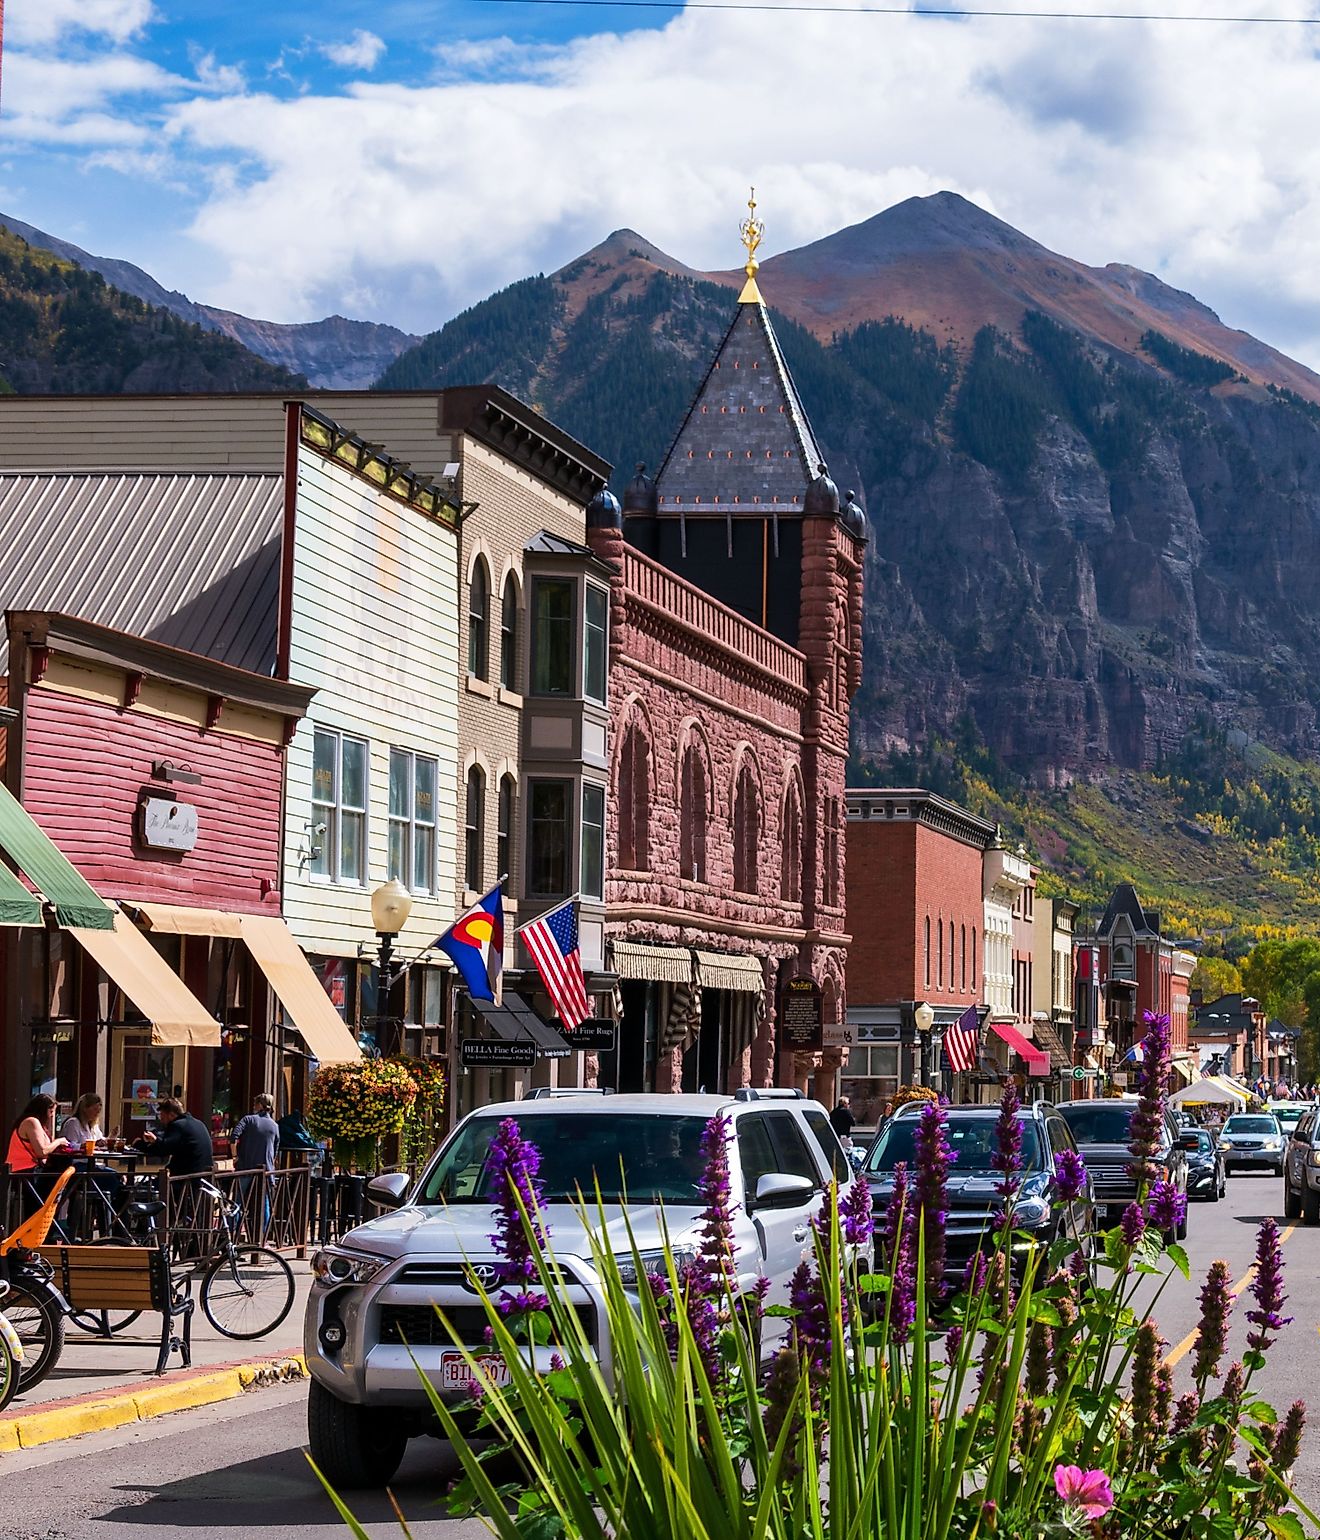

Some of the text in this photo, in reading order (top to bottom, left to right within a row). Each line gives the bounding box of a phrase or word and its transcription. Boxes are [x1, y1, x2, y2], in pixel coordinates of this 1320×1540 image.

[597, 1027, 613, 1036] Rugs
[464, 1045, 491, 1053] BELLA
[494, 1046, 509, 1054] Fine
[511, 1046, 534, 1054] Goods
